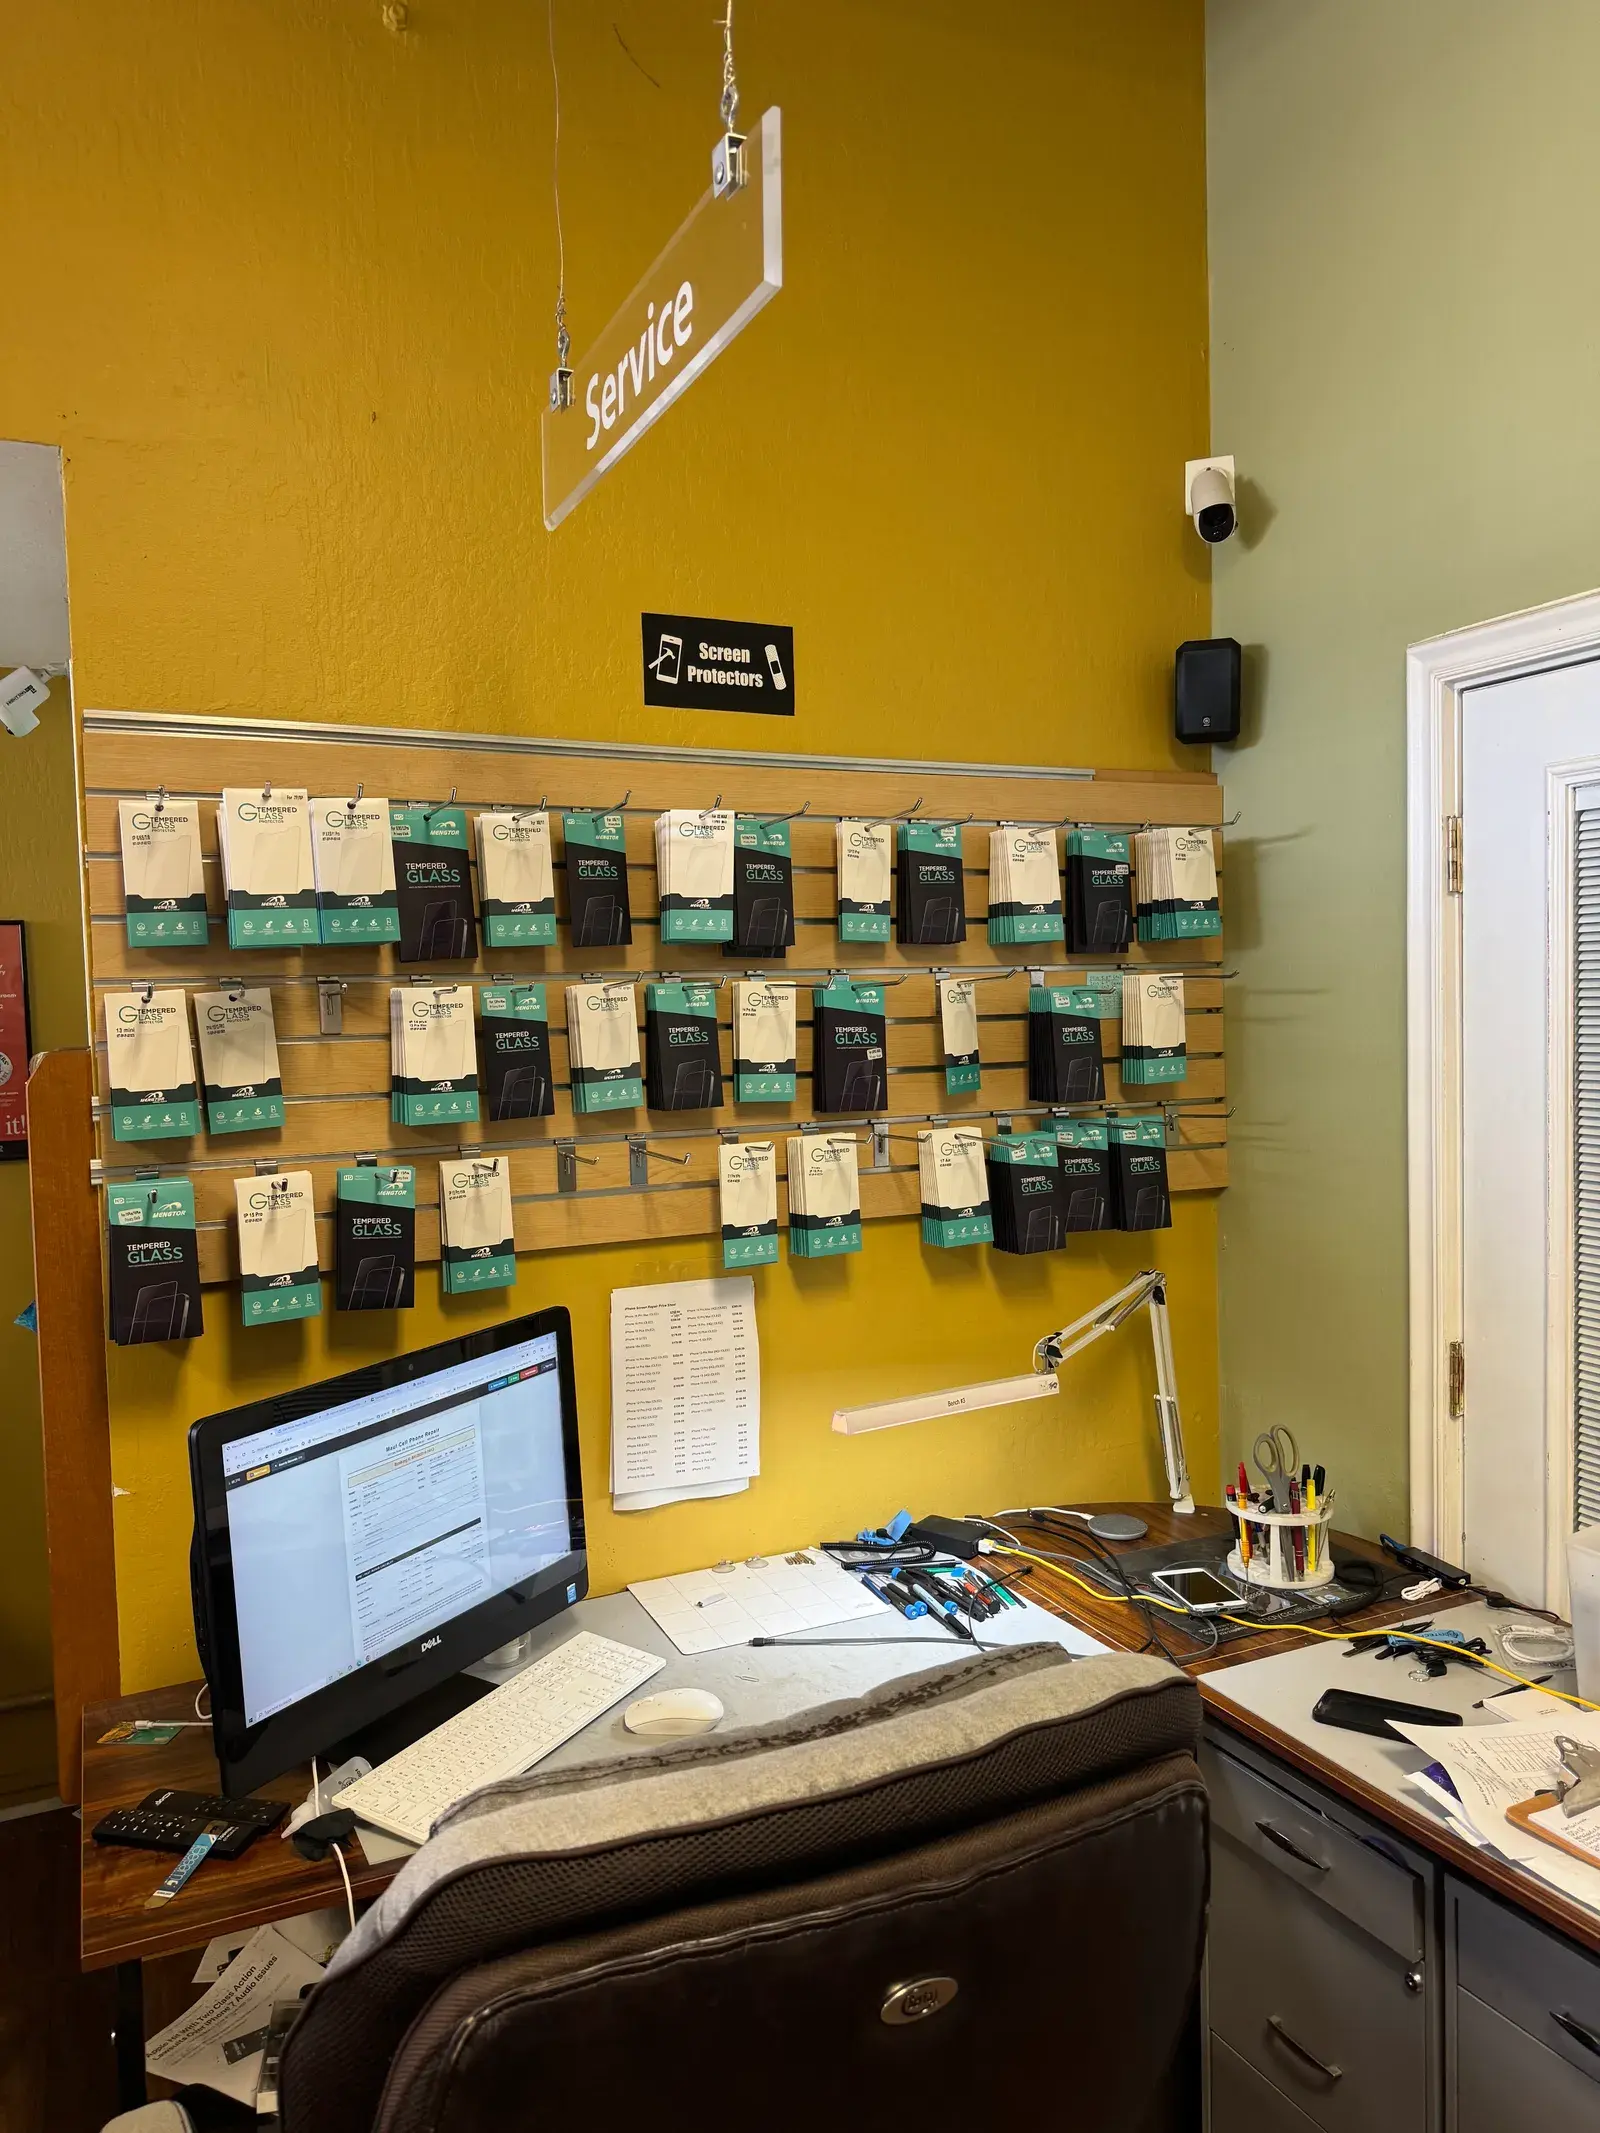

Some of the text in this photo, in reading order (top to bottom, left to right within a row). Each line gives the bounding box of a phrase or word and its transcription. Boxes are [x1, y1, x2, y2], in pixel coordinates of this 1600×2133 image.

[586, 280, 693, 451] Service
[699, 642, 751, 663] Screen
[687, 665, 764, 688] Protectors
[150, 816, 188, 824] TEMPERED
[405, 862, 447, 870] TEMPERED
[578, 866, 618, 877] GLASS
[406, 869, 461, 883] GLASS
[746, 870, 784, 881] GLASS
[919, 871, 955, 881] GLASS
[1092, 875, 1124, 885] GLASS
[495, 1031, 529, 1039] TEMPERED
[668, 1031, 709, 1044] GLASS
[835, 1032, 877, 1044] GLASS
[1062, 1031, 1095, 1042] GLASS
[495, 1037, 540, 1050] GLASS
[5, 1114, 26, 1135] it!
[1065, 1163, 1100, 1174] GLASS
[1130, 1160, 1161, 1173] GLASS
[468, 1172, 500, 1180] TEMPERED
[1021, 1175, 1046, 1184] TEMPERED
[1021, 1180, 1053, 1193] GLASS
[266, 1192, 304, 1201] TEMPERED
[152, 1210, 186, 1219] MENGTOR
[352, 1224, 402, 1236] GLASS
[127, 1241, 171, 1251] TEMPERED
[127, 1247, 183, 1264] GLASS
[947, 1399, 960, 1407] Bench
[408, 1434, 424, 1443] Phone
[424, 1427, 440, 1437] Repair
[421, 1634, 442, 1653] DELL
[146, 1965, 257, 2058] Apple Hit With Two Class Action
[152, 2036, 188, 2061] Lawsuits
[186, 2024, 206, 2040] Over
[204, 2006, 231, 2028] iPhone
[235, 1981, 257, 2003] Audio
[256, 1955, 278, 1982] Issues
